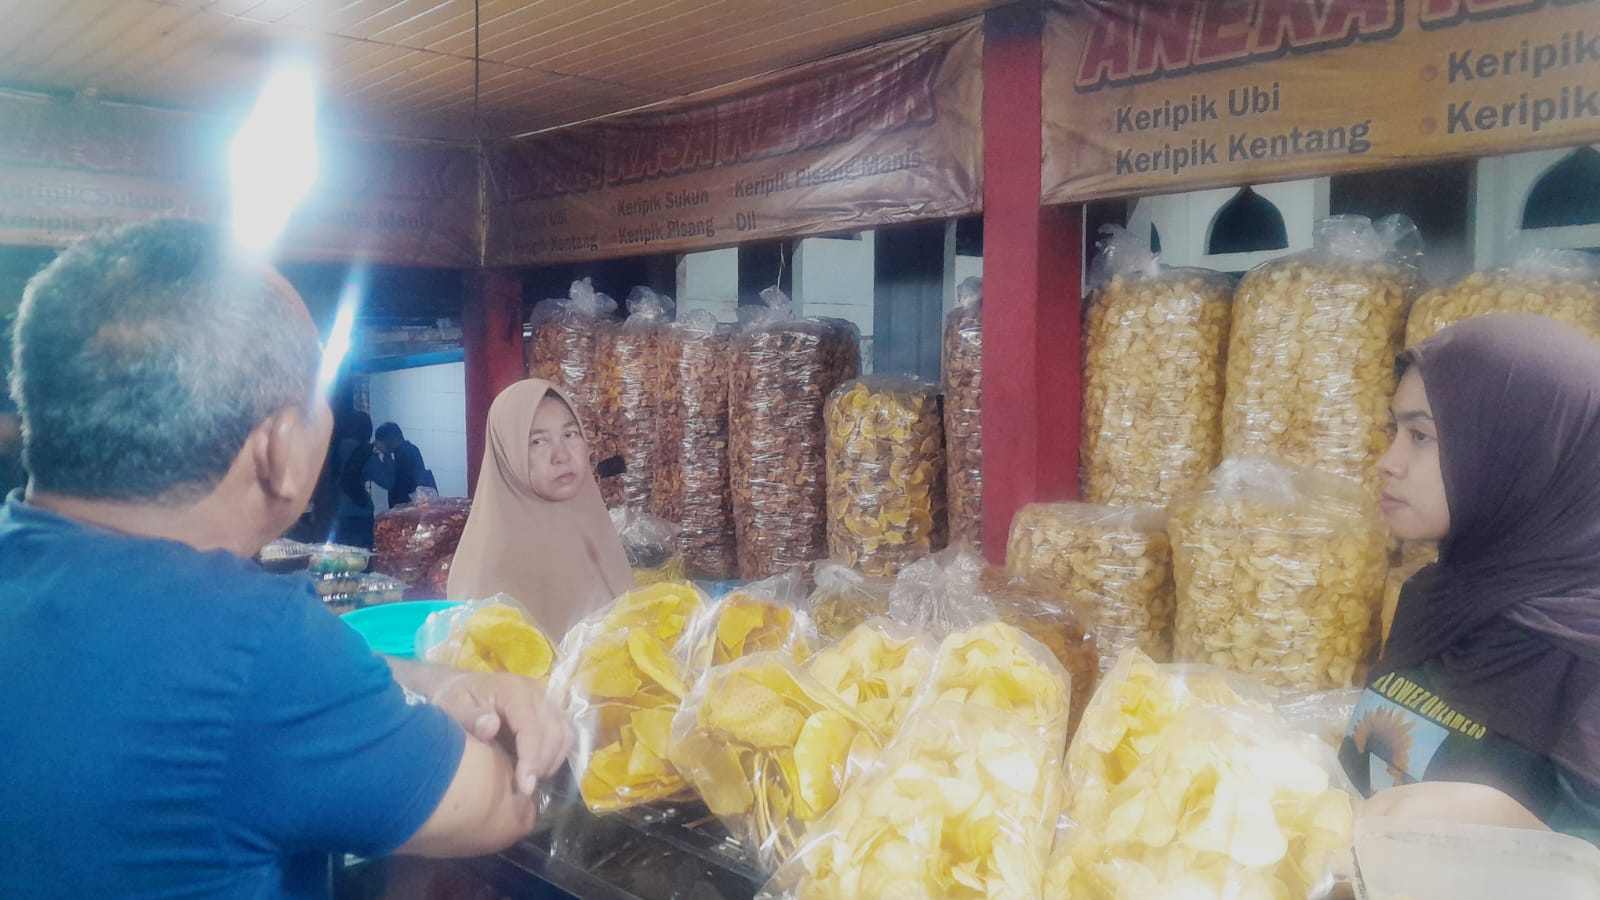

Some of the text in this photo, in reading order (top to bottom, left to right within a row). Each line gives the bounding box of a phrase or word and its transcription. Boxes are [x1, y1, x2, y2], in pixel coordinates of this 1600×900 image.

[1448, 30, 1600, 83] Keripik
[1116, 83, 1280, 133] Keripik Ubi
[1447, 85, 1600, 134] Keripik
[1116, 119, 1372, 175] Keripik Kentang
[617, 190, 709, 217] Keripik Sukun
[735, 171, 789, 198] Keripik
[667, 216, 716, 238] Pisang
